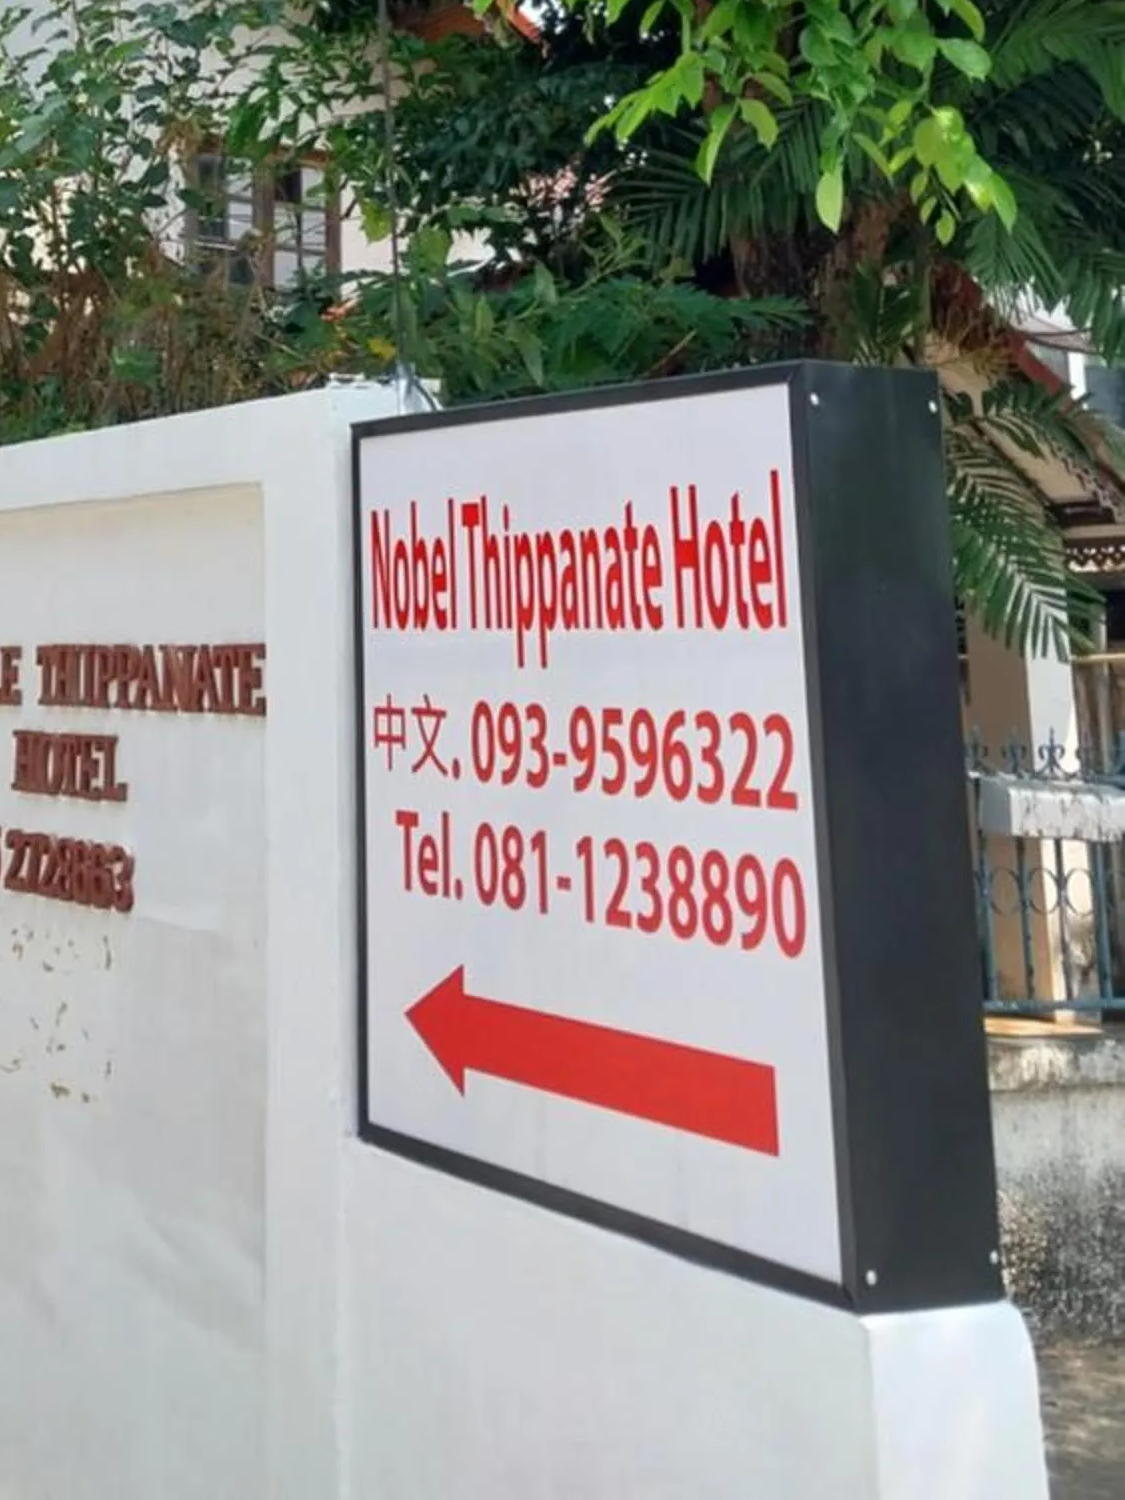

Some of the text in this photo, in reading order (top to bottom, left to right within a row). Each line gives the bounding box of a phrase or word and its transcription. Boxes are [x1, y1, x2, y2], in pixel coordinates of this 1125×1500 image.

[370, 468, 789, 668] Nobel Thippanate Hotel
[36, 643, 266, 716] THIPPANATE
[11, 730, 127, 802] HOTEL
[470, 700, 799, 812] 093-9596322
[395, 810, 808, 959] Tel. 081-1238890
